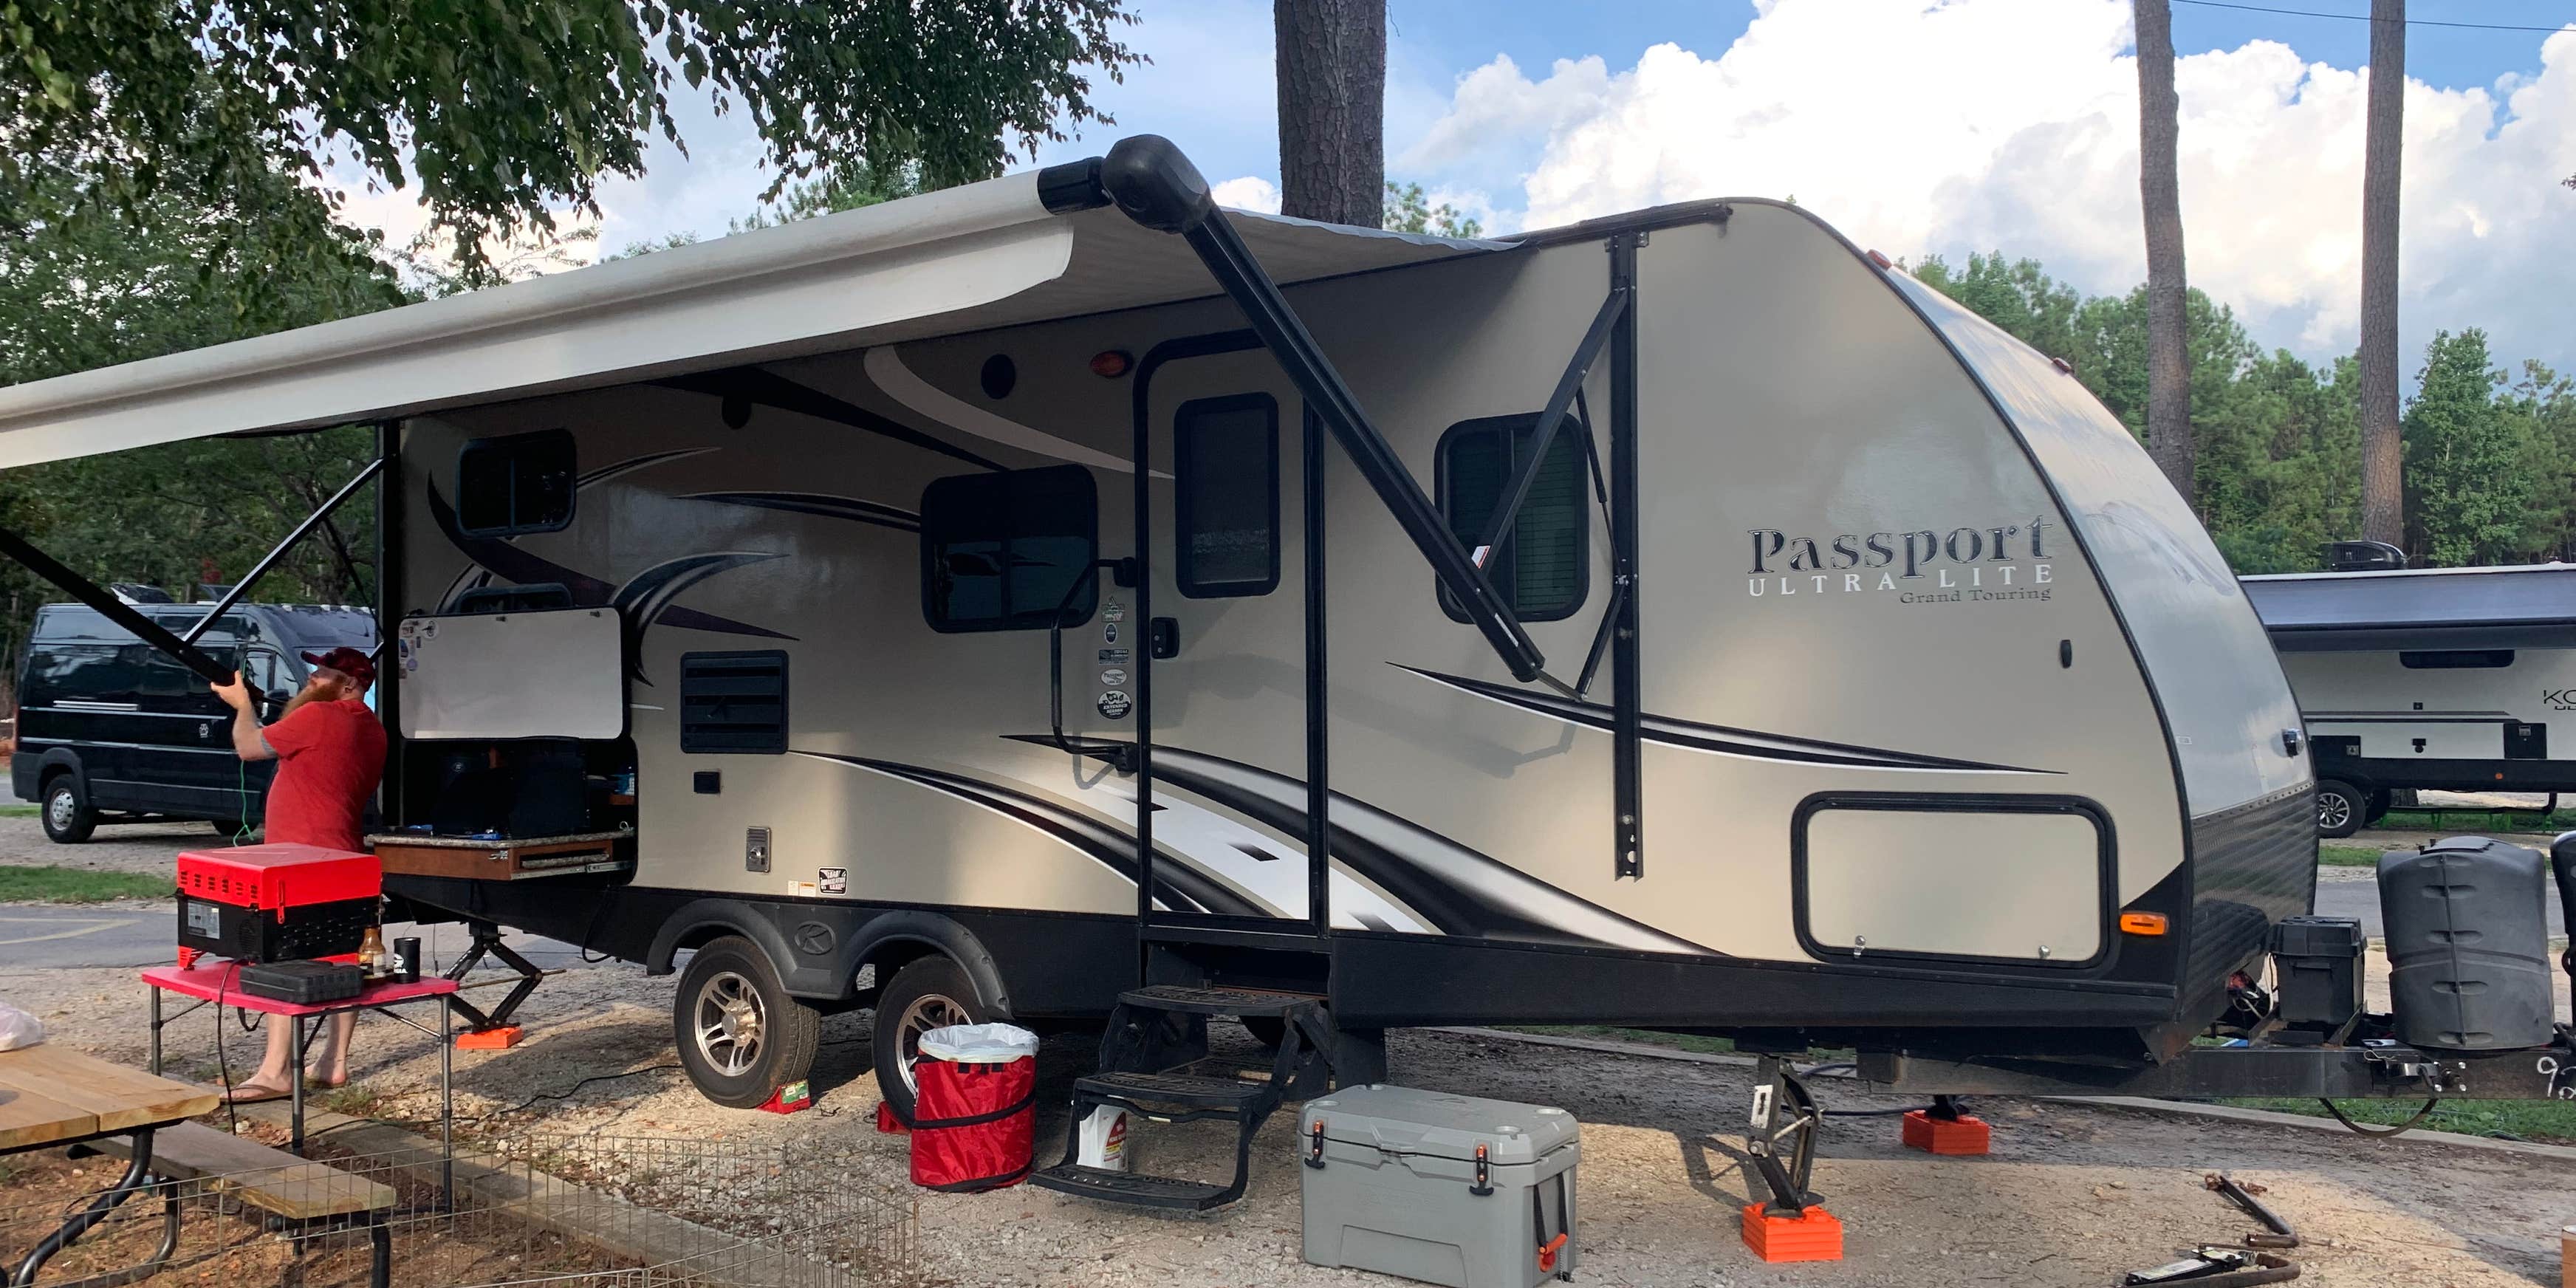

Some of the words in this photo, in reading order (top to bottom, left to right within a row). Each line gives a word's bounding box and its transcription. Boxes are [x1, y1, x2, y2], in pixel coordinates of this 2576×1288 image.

[1747, 515, 2055, 579] Passport
[1748, 572, 1897, 597] ULTRA
[1939, 564, 2052, 588] LITE
[1900, 589, 1962, 604] Grand
[1968, 586, 2052, 602] Touring
